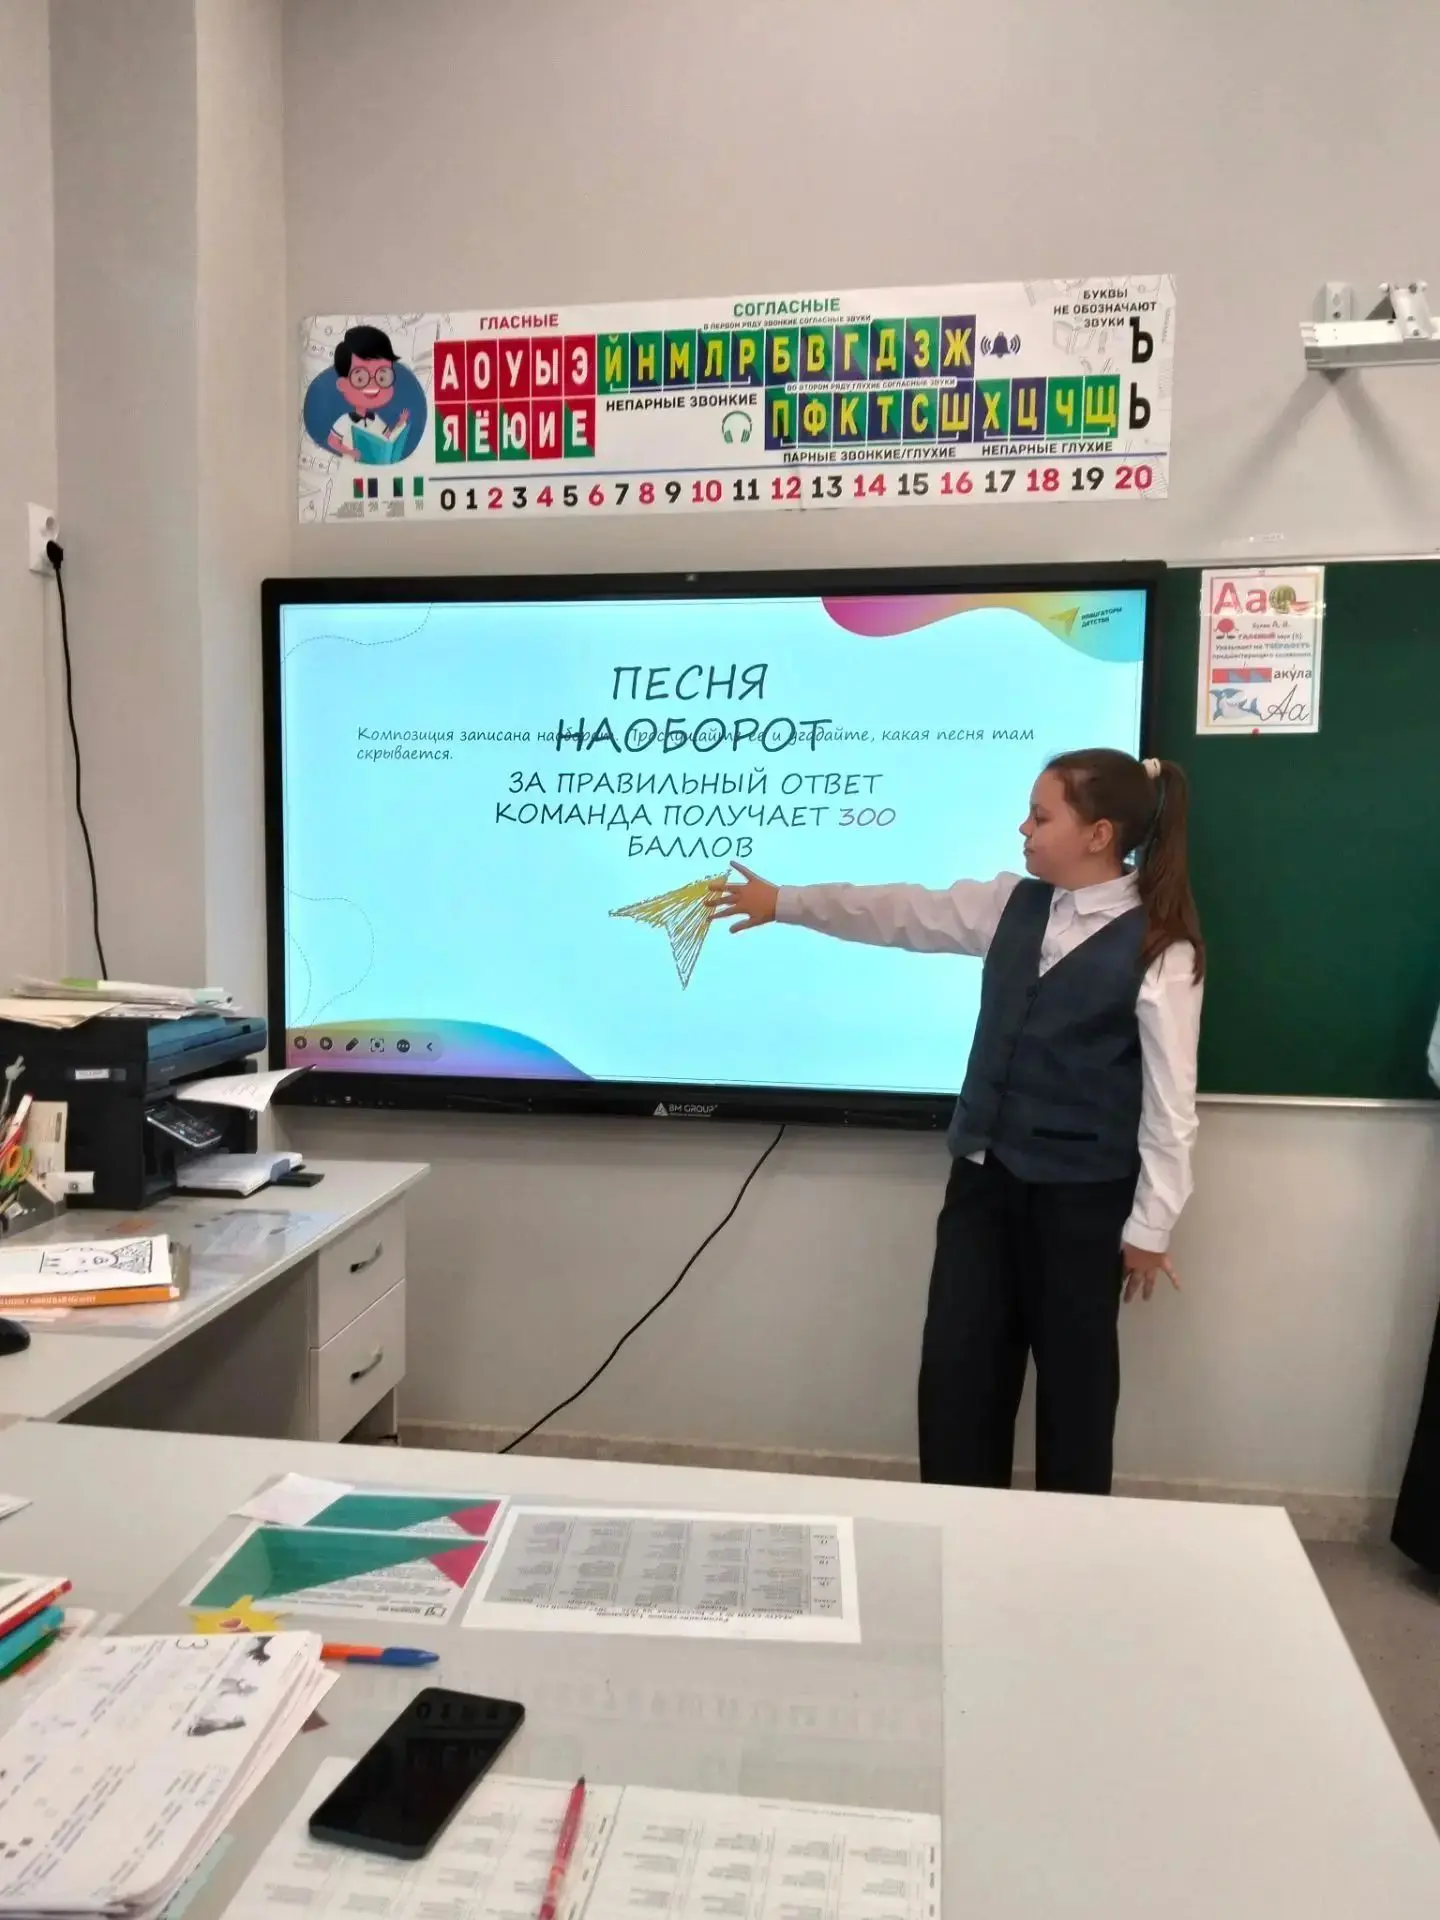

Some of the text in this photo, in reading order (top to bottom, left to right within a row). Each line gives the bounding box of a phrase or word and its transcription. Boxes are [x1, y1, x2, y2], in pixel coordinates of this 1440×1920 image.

[1083, 288, 1128, 300] БУКВЫ
[733, 297, 841, 318] СОГЛАСНЫЕ
[1053, 301, 1157, 316] НЕ ОБОЗНАЧАЮТ
[480, 313, 559, 331] ГЛАСНЫЕ
[1084, 317, 1124, 328] ЗВУКИ
[1130, 316, 1154, 363] Ъ
[638, 346, 654, 380] Н
[670, 342, 690, 378] М
[704, 340, 722, 377] Л
[739, 339, 756, 375] Р
[772, 335, 791, 374] Б
[807, 334, 825, 372] В
[844, 333, 859, 371] Г
[876, 328, 897, 371] Д
[944, 328, 971, 367] Ж
[441, 346, 588, 391] А О У Ы Э
[606, 393, 757, 412] НЕПАРНЫЕ ЗВОНКИЕ
[804, 398, 826, 436] Ф
[841, 397, 858, 435] К
[877, 395, 893, 432] Т
[912, 394, 928, 432] С
[942, 393, 970, 431] Ш
[982, 392, 1000, 430] Х
[1017, 388, 1037, 431] Ц
[1056, 389, 1074, 427] Ч
[1086, 386, 1117, 429] Щ
[1129, 381, 1151, 429] Ь
[443, 408, 587, 453] Я Ё Ю И Е
[783, 447, 956, 462] ПАРНЫЕ ЗВОНКИЕ/ГЛУХИЕ
[982, 441, 1113, 455] НЕПАРНЫЕ ГЛУХИЕ
[440, 464, 1153, 510] 0 1 2 3 4 5 6 7 8 9 10 11 12 13 14 15 16 17 18 19 20
[613, 663, 768, 701] ПЕСНЯ
[357, 727, 454, 744] Композиция
[459, 731, 530, 742] записана
[882, 729, 930, 741] какая
[936, 729, 984, 741] песня
[992, 729, 1034, 741] там
[556, 716, 832, 754] НАОБОРОТ
[357, 745, 453, 762] скрывается.
[508, 767, 883, 795] ЗА ПРАВИЛЬНЫЙ ОТВЕТ
[495, 802, 896, 831] КОМАНДА ПОЛУЧАЕТ 300
[628, 835, 753, 858] БАЛЛОВ
[668, 1104, 682, 1112] BM
